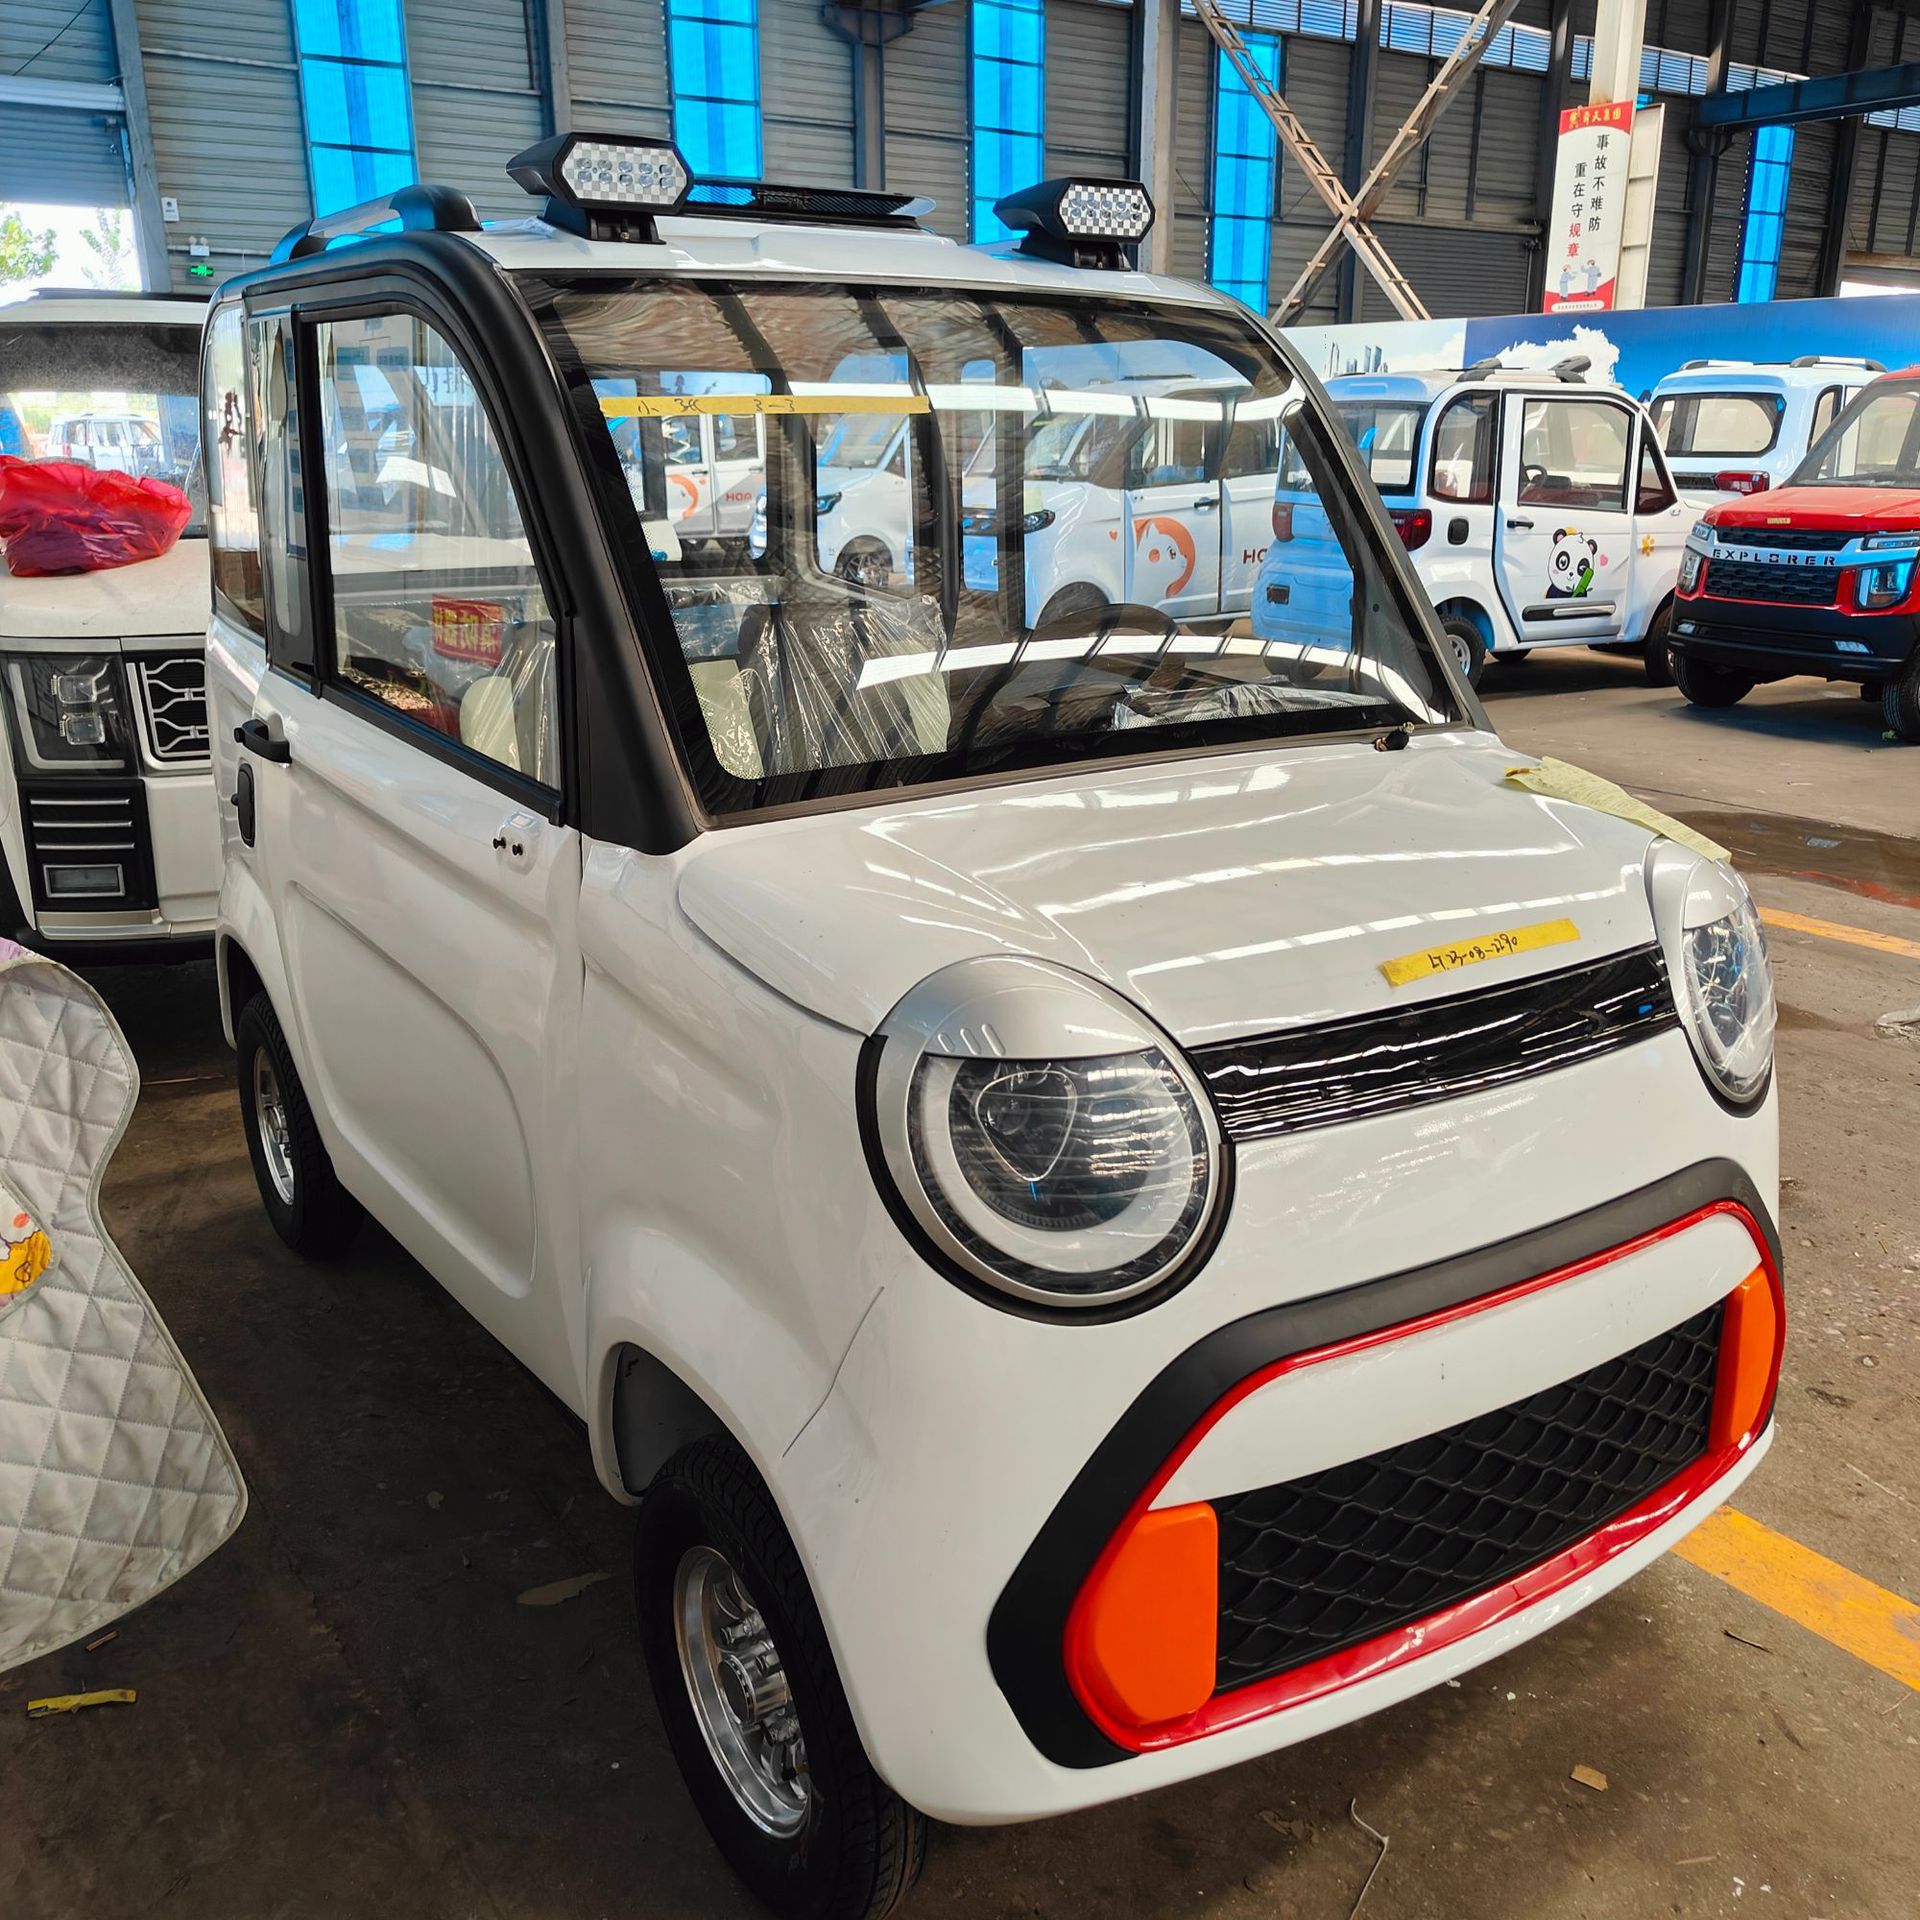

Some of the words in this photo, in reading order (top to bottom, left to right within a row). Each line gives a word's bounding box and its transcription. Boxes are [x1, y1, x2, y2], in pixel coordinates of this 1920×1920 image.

[1566, 162, 1588, 257] 重在守规章
[1588, 134, 1610, 232] 事故不难防
[1712, 548, 1836, 567] EXPLORER
